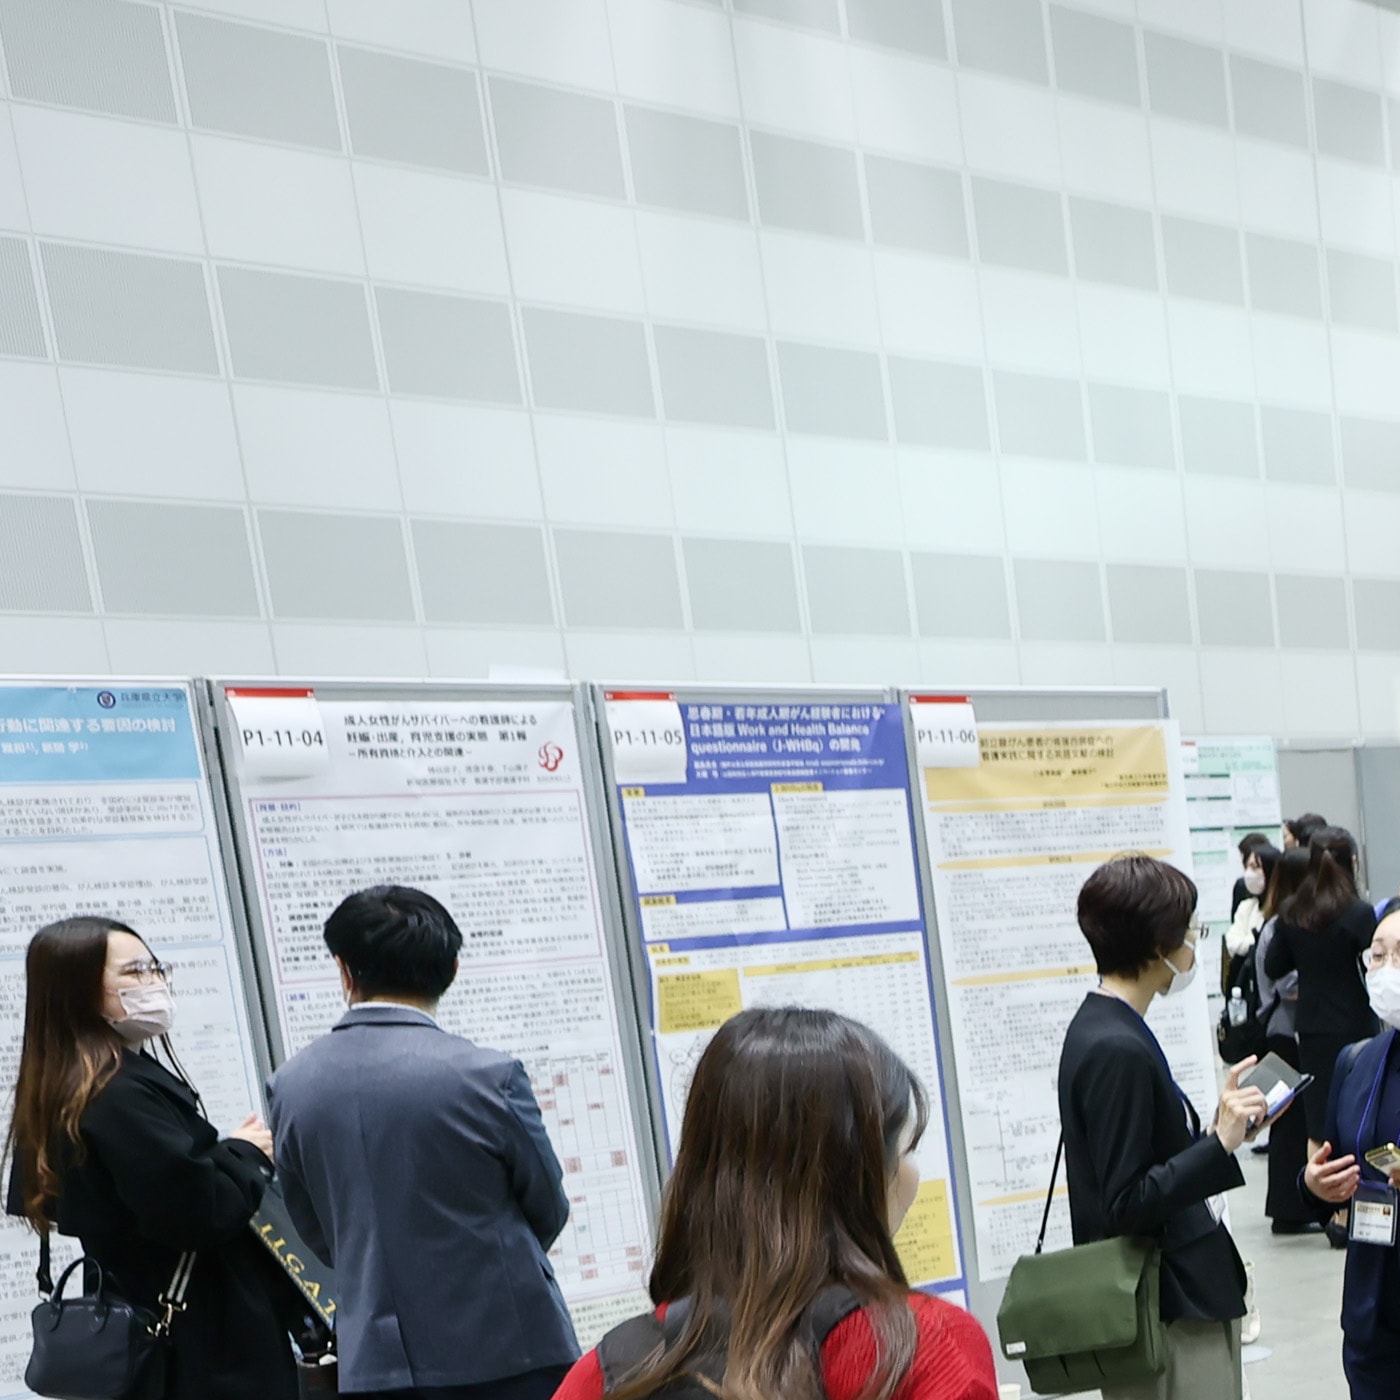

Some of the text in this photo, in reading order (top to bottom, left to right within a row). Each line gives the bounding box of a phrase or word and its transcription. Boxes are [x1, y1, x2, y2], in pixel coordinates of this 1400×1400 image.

[737, 724, 766, 735] Work
[768, 725, 789, 736] and
[791, 723, 826, 736] Health
[828, 722, 870, 735] Balance
[918, 730, 976, 744] P1-11-06
[243, 729, 324, 747] P1-11-04
[614, 729, 683, 746] P1-11-05
[691, 740, 768, 756] questionnaire
